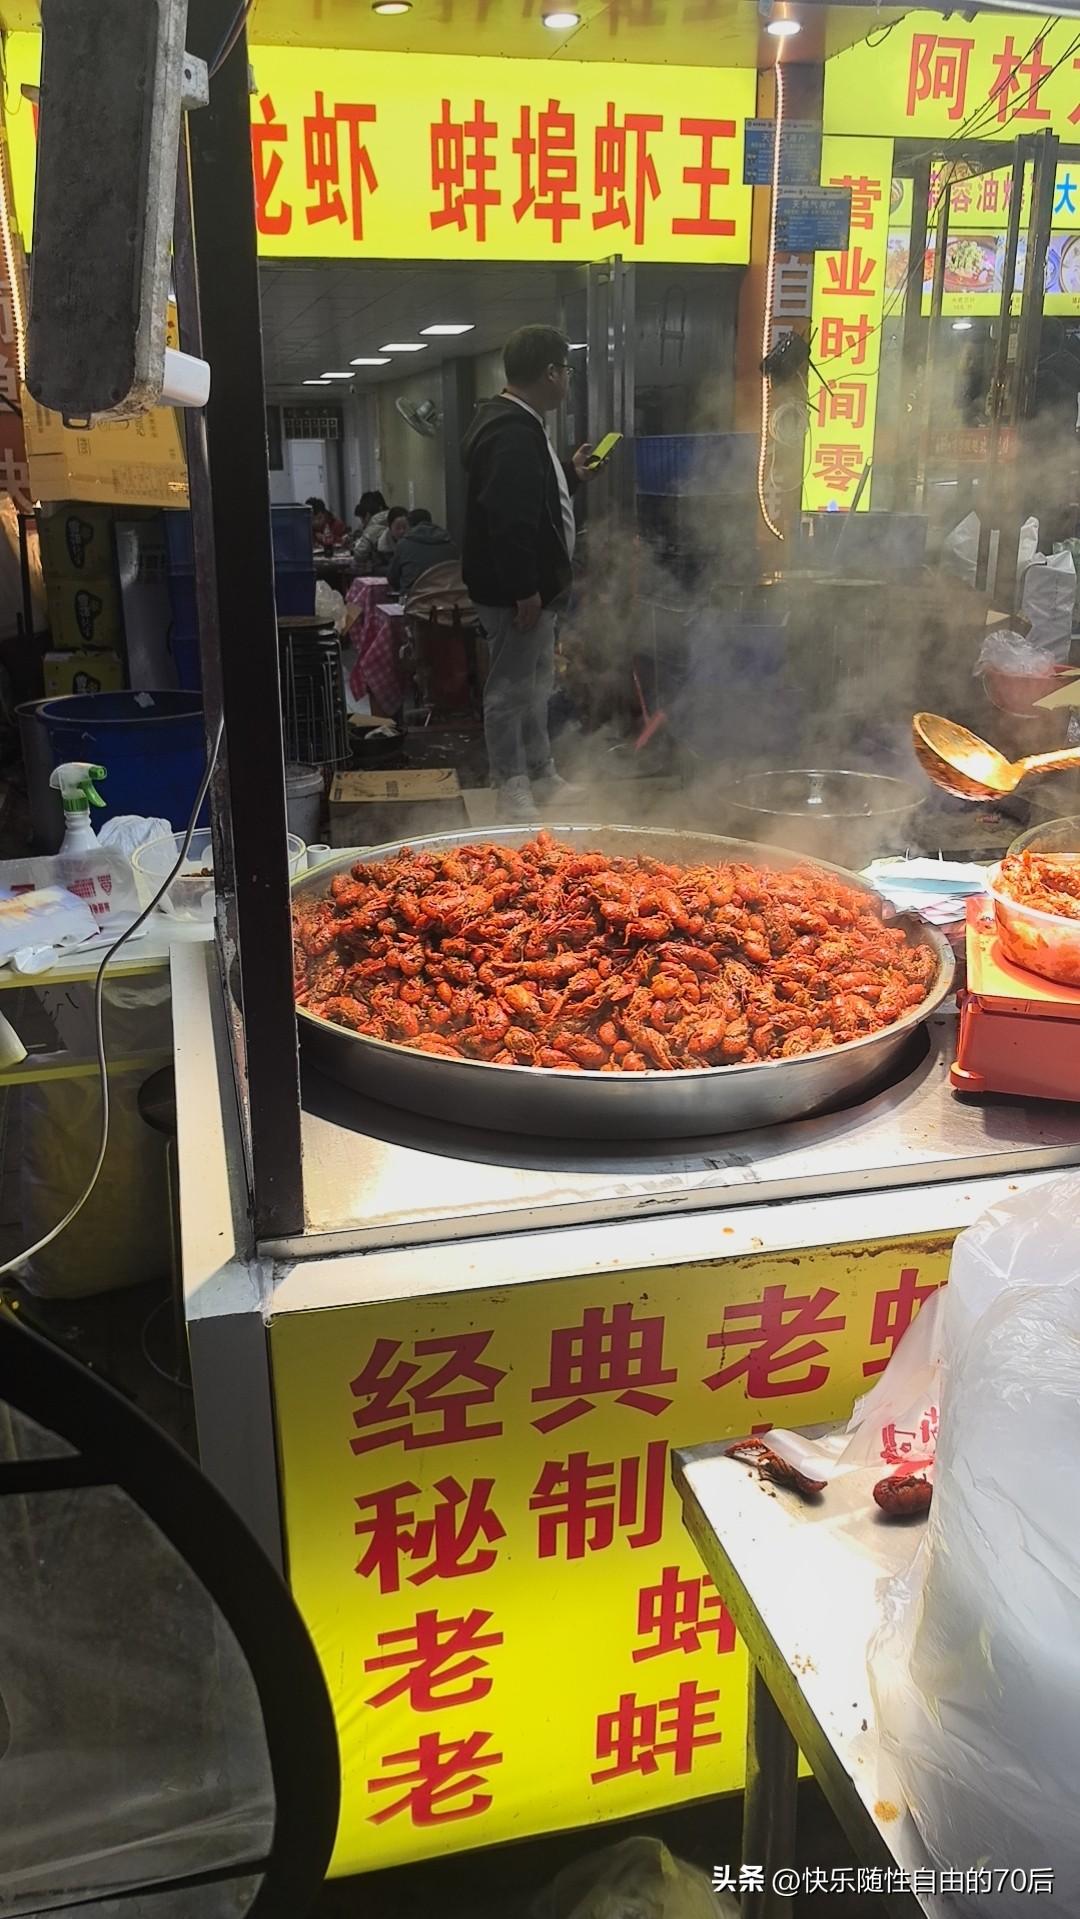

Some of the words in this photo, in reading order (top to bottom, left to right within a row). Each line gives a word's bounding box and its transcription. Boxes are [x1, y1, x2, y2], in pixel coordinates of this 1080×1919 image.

[906, 33, 1080, 124] 阿杜
[429, 98, 737, 245] 蚌埠虾王
[812, 175, 882, 512] 营业时间零
[353, 1423, 774, 1596] 秘制
[363, 1608, 504, 1713] 老
[366, 1731, 503, 1828] 老
[590, 1680, 722, 1785] 蚌
